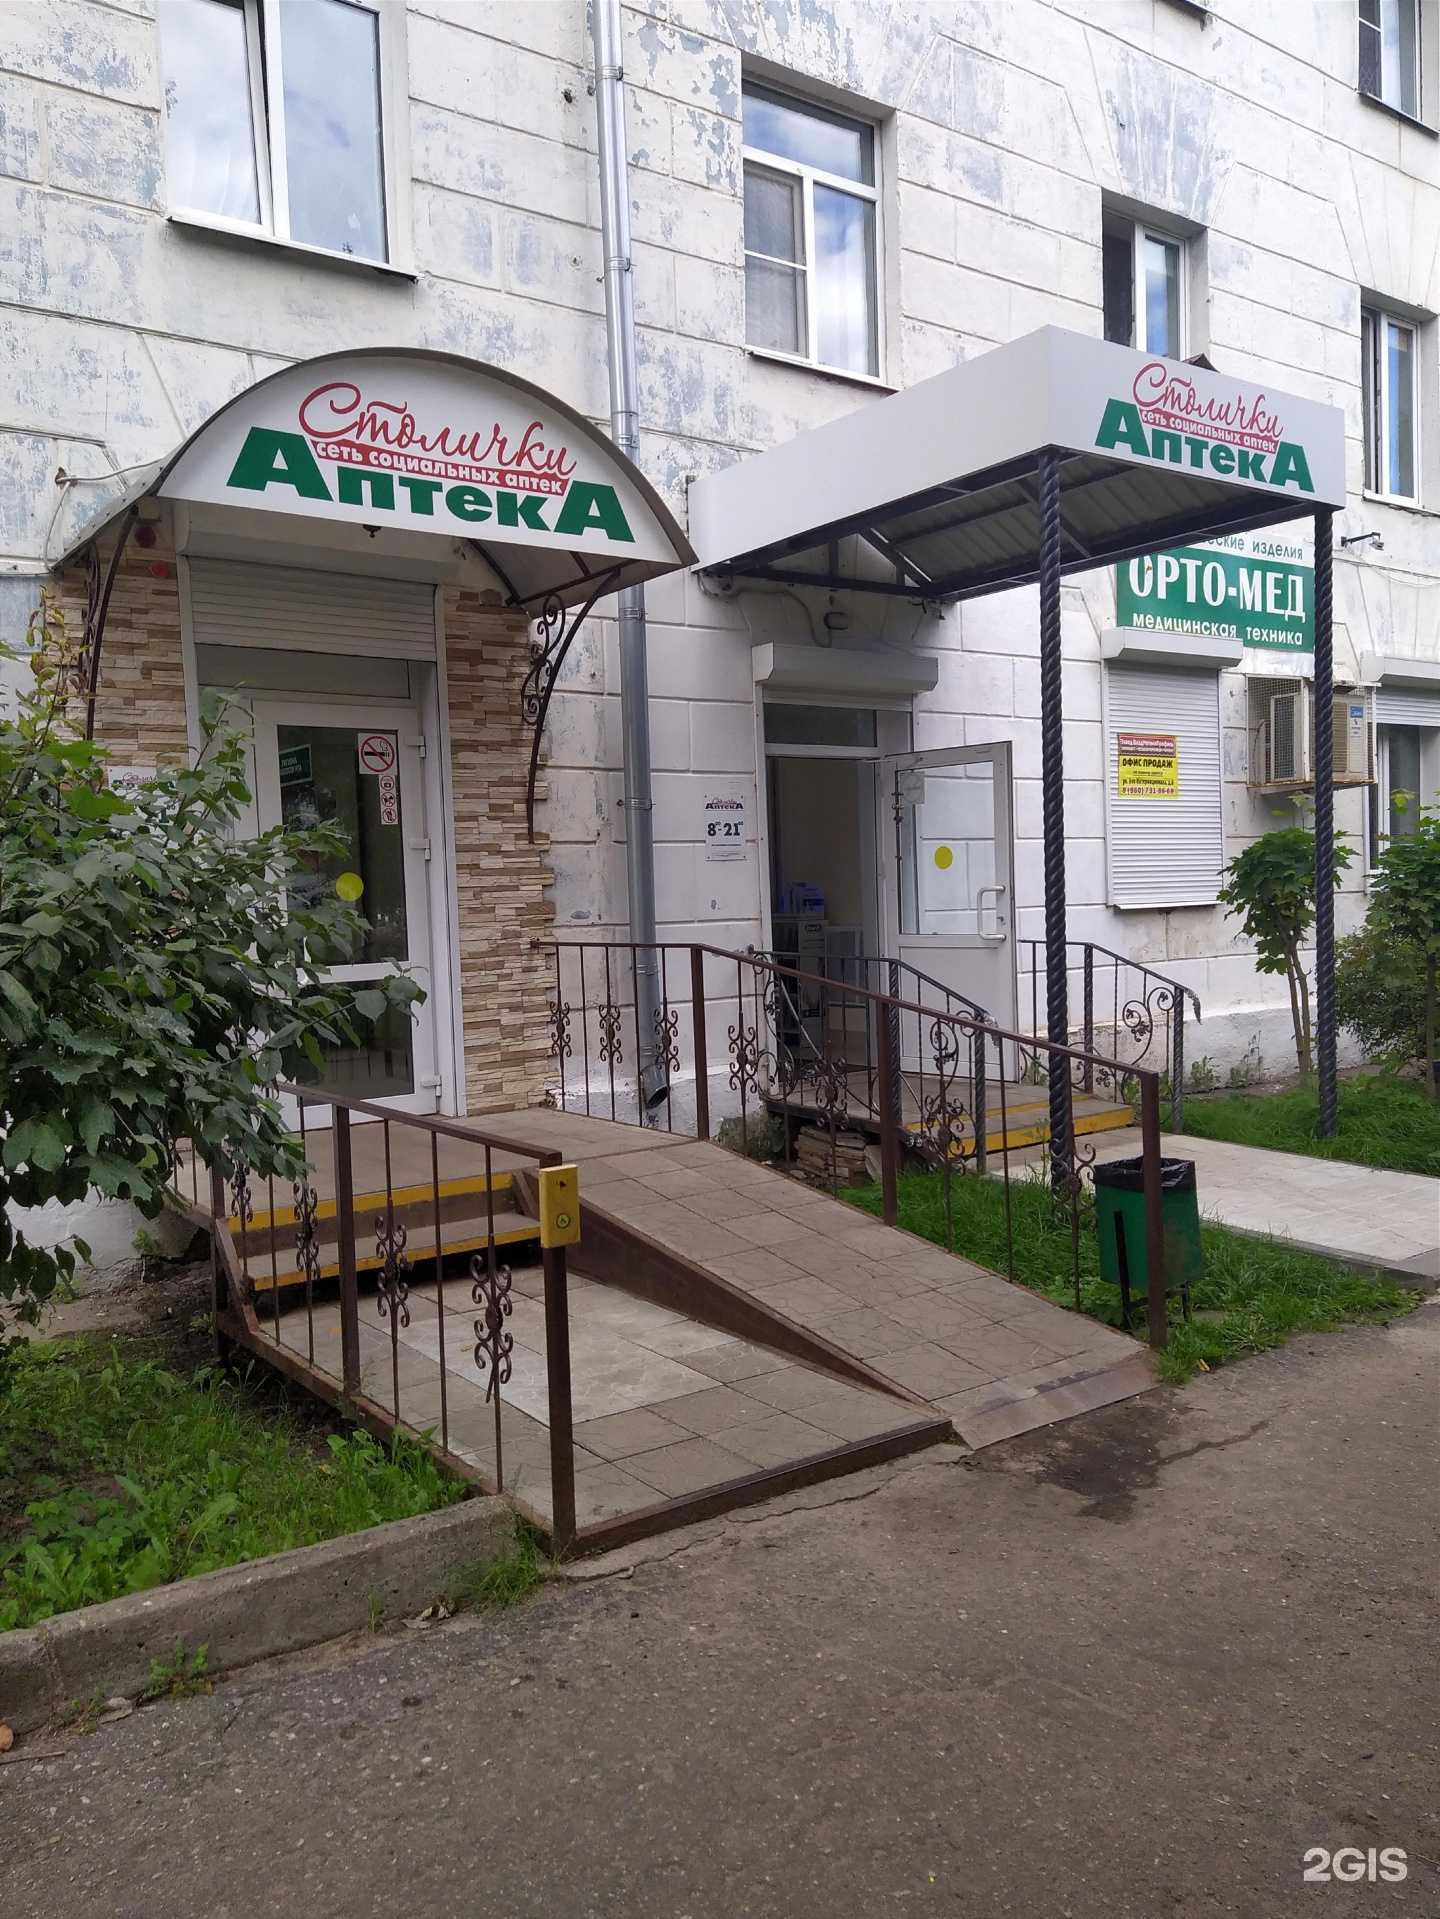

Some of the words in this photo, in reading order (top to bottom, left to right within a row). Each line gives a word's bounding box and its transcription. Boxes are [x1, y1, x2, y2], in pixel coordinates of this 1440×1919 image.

[1133, 363, 1284, 438] Столички
[299, 382, 577, 477] Столички
[1141, 409, 1168, 426] сеть
[1169, 416, 1241, 443] социальных
[1243, 433, 1276, 452] аптек
[315, 440, 363, 463] сеть
[369, 449, 500, 486] социальных
[504, 470, 563, 496] аптек
[1252, 540, 1303, 560] изделия
[1129, 554, 1305, 623] ОРТО-МЕД
[1132, 612, 1237, 639] медицинская
[1246, 626, 1303, 646] техника
[1122, 758, 1142, 768] ОФИС
[1143, 759, 1174, 769] ПРОДАЖ
